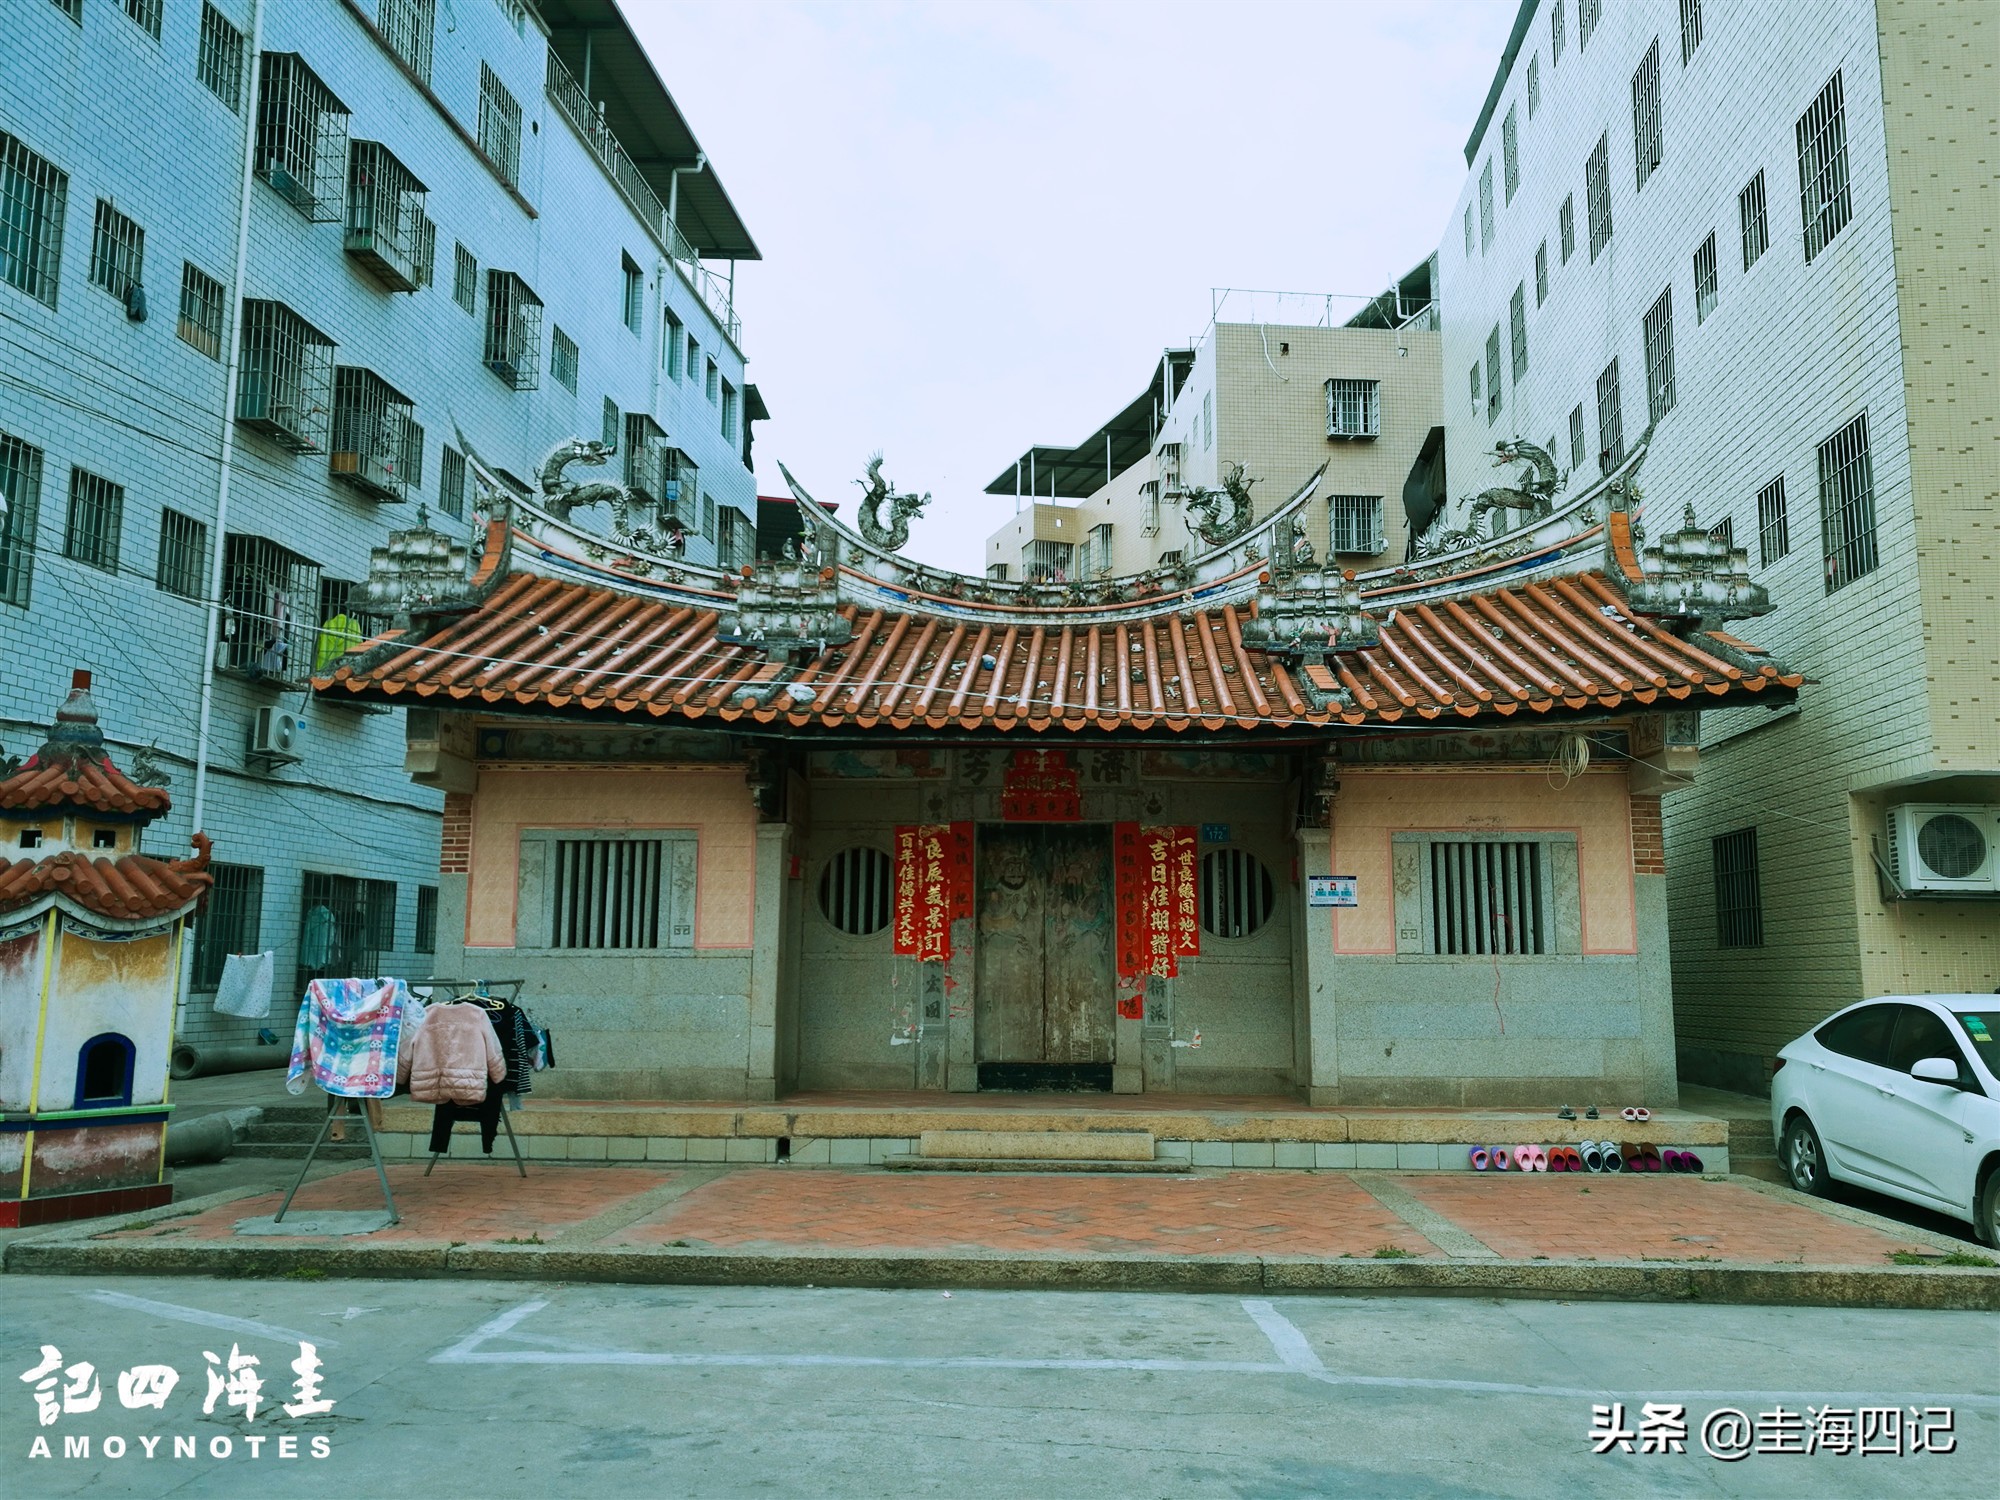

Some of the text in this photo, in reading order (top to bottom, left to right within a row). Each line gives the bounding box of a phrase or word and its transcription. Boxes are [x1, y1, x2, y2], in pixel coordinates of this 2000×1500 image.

[898, 833, 916, 947] 百年佳偶共天長
[1209, 831, 1224, 840] 172
[923, 838, 945, 961] 良辰美景訂
[1149, 839, 1171, 979] 吉日佳期諧好
[1177, 837, 1197, 949] 一世良緣同地久
